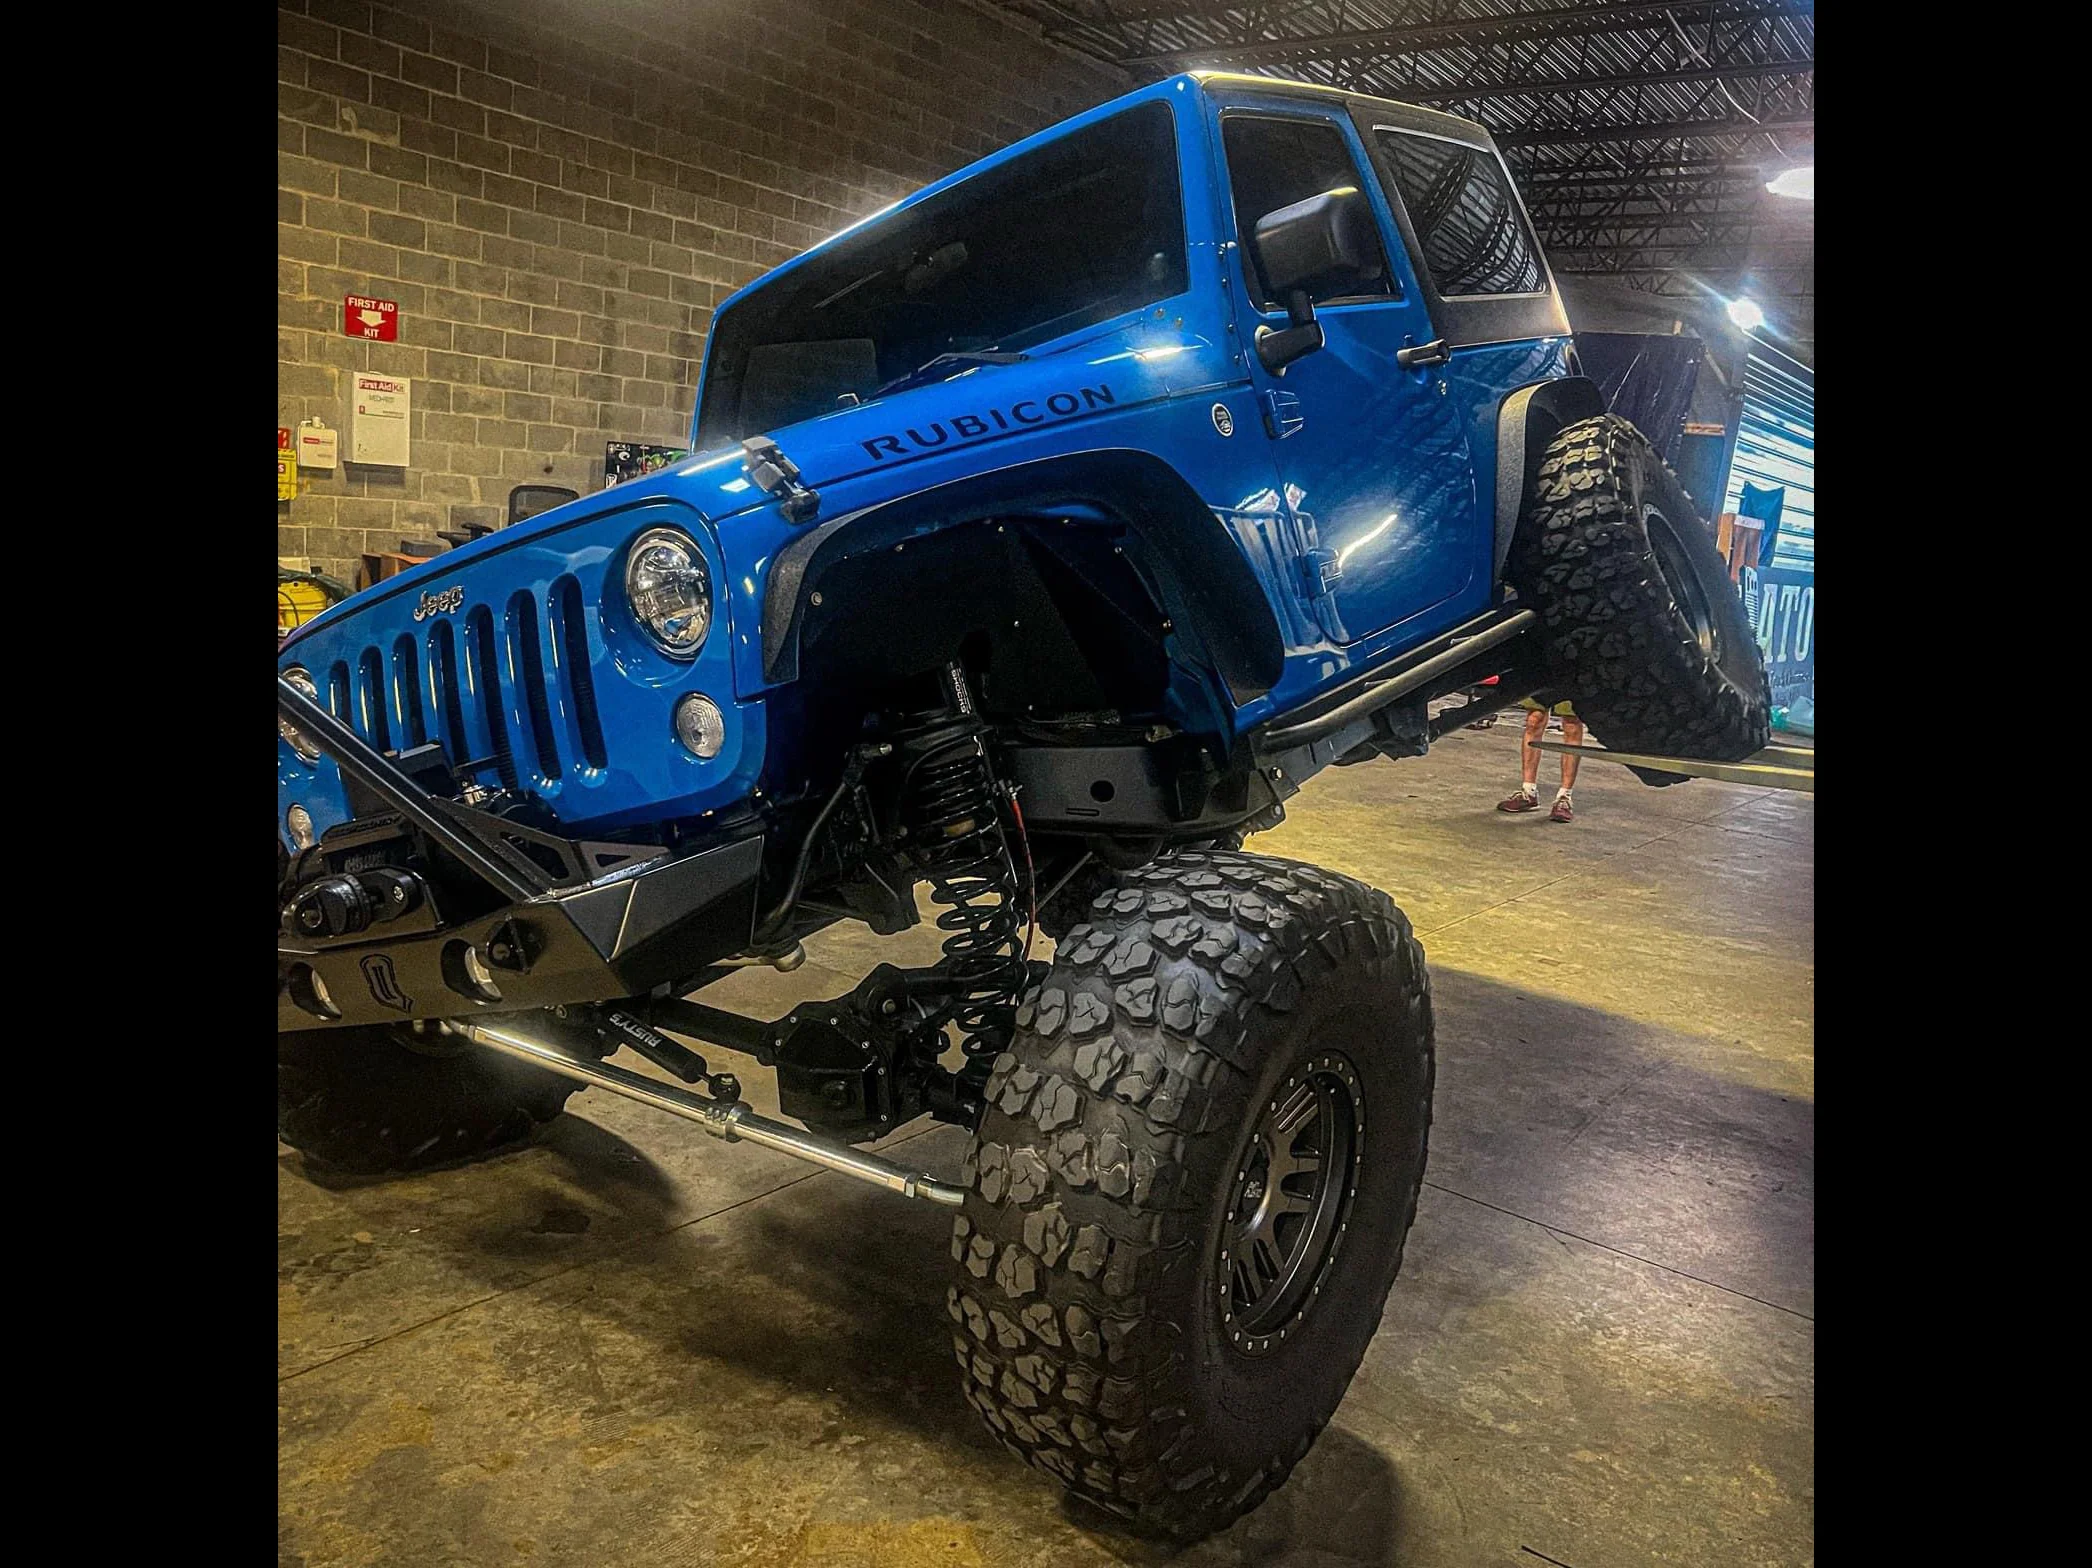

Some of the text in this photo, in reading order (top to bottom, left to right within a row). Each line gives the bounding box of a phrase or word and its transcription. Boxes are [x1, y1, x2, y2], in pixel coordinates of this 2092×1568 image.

[348, 297, 395, 312] FIRST AID
[364, 327, 379, 338] KIT
[359, 380, 377, 390] First
[861, 384, 1116, 461] RUBICON
[413, 585, 463, 621] Jeep
